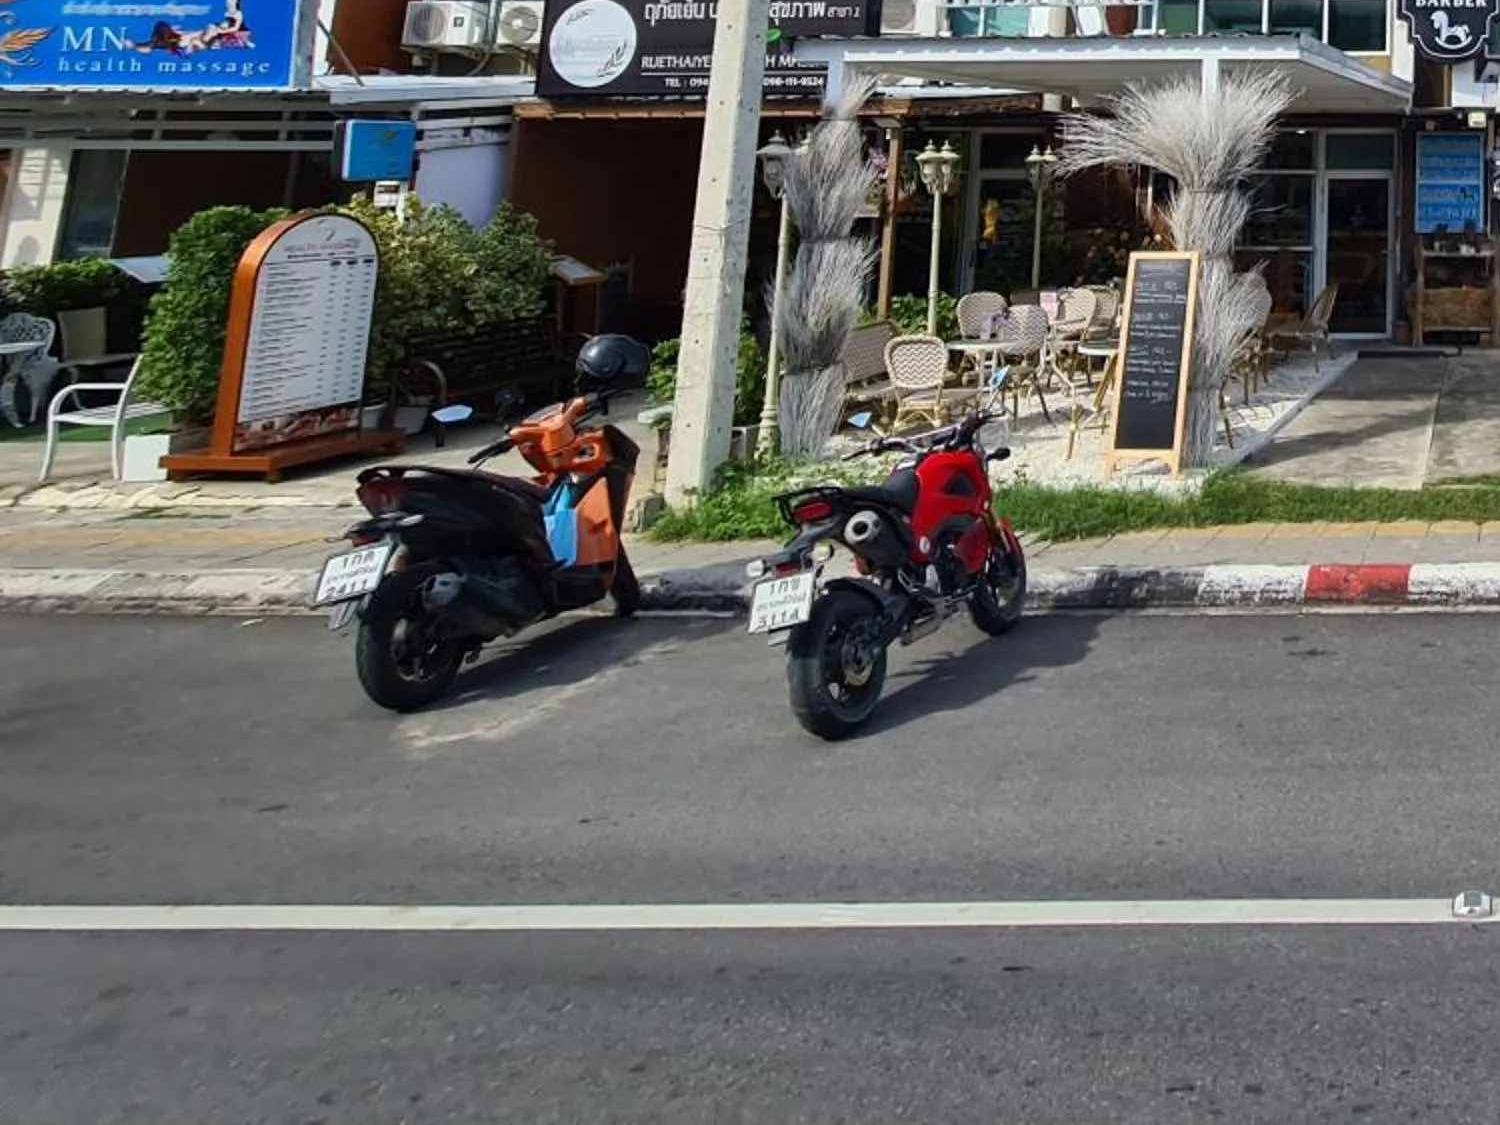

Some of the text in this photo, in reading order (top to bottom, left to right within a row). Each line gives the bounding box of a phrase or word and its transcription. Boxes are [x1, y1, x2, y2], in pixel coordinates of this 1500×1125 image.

[60, 26, 128, 52] MN
[57, 57, 271, 76] health massage
[641, 55, 711, 69] RUETHAIYE
